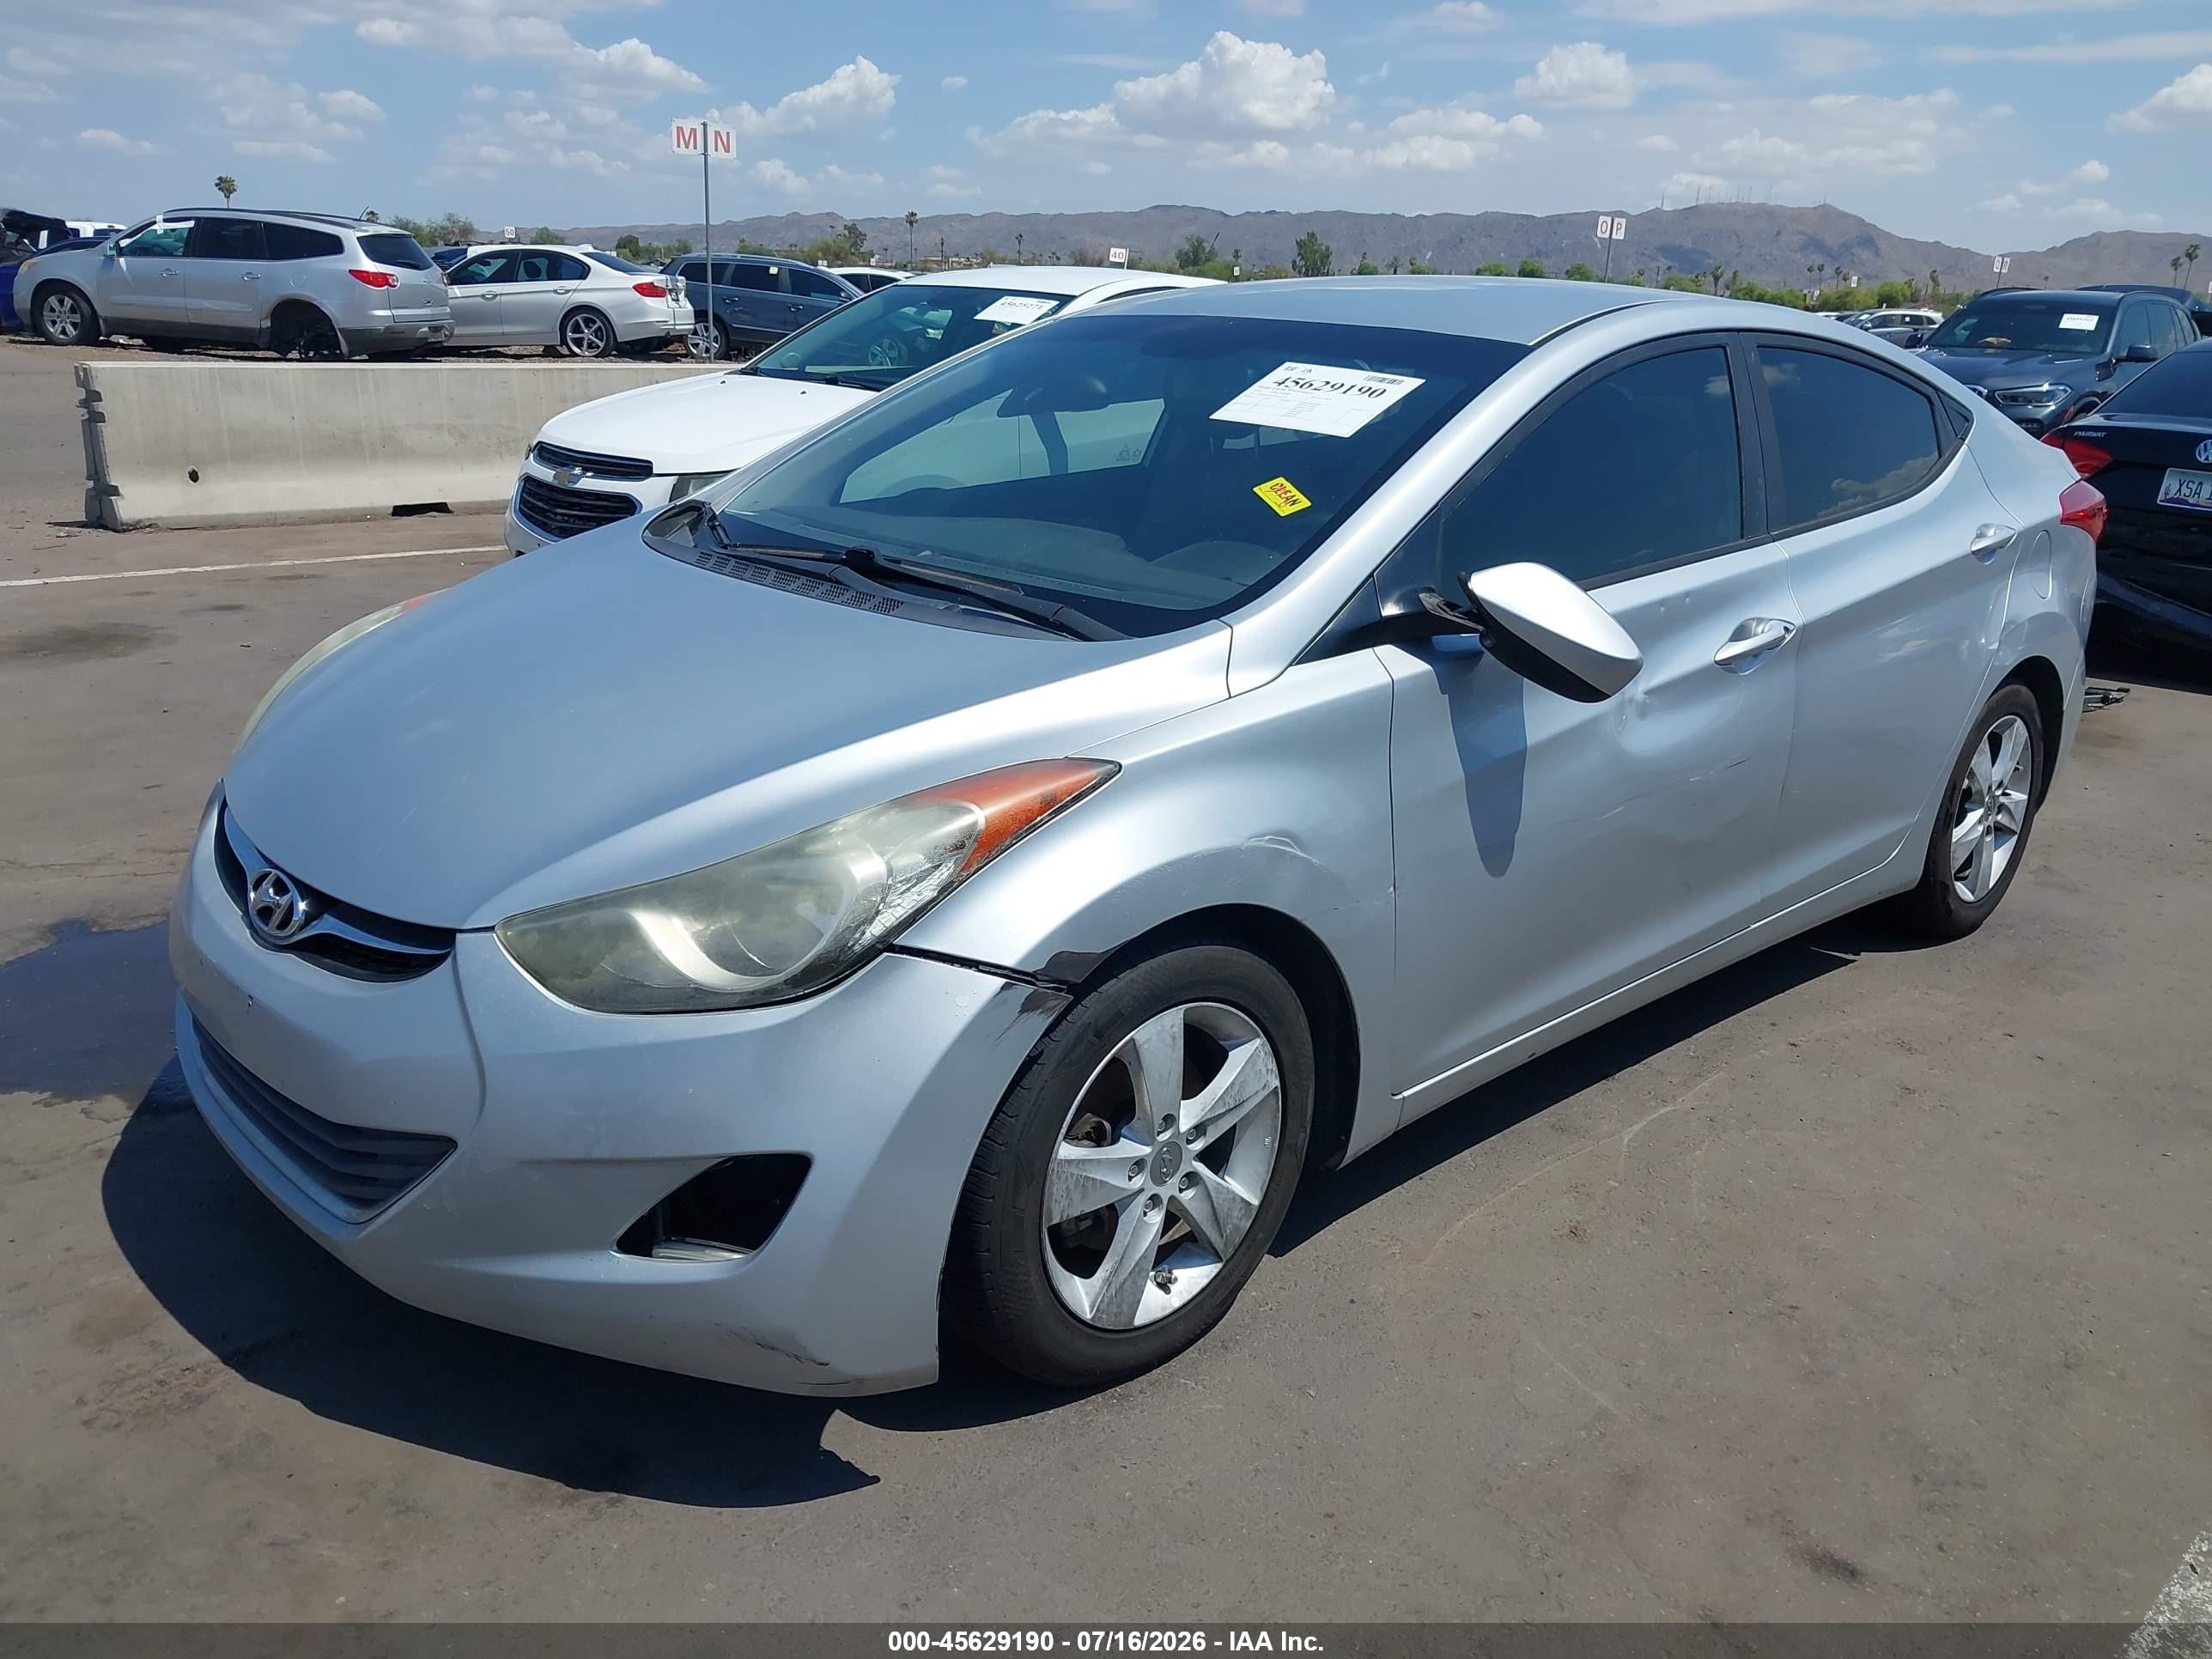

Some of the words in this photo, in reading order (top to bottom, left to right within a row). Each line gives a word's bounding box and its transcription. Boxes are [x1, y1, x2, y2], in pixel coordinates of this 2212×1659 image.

[676, 125, 697, 150] M
[714, 130, 731, 154] N
[1615, 222, 1623, 236] P
[1111, 251, 1124, 259] 40
[1273, 376, 1388, 398] 45629190
[2174, 478, 2203, 498] XSA
